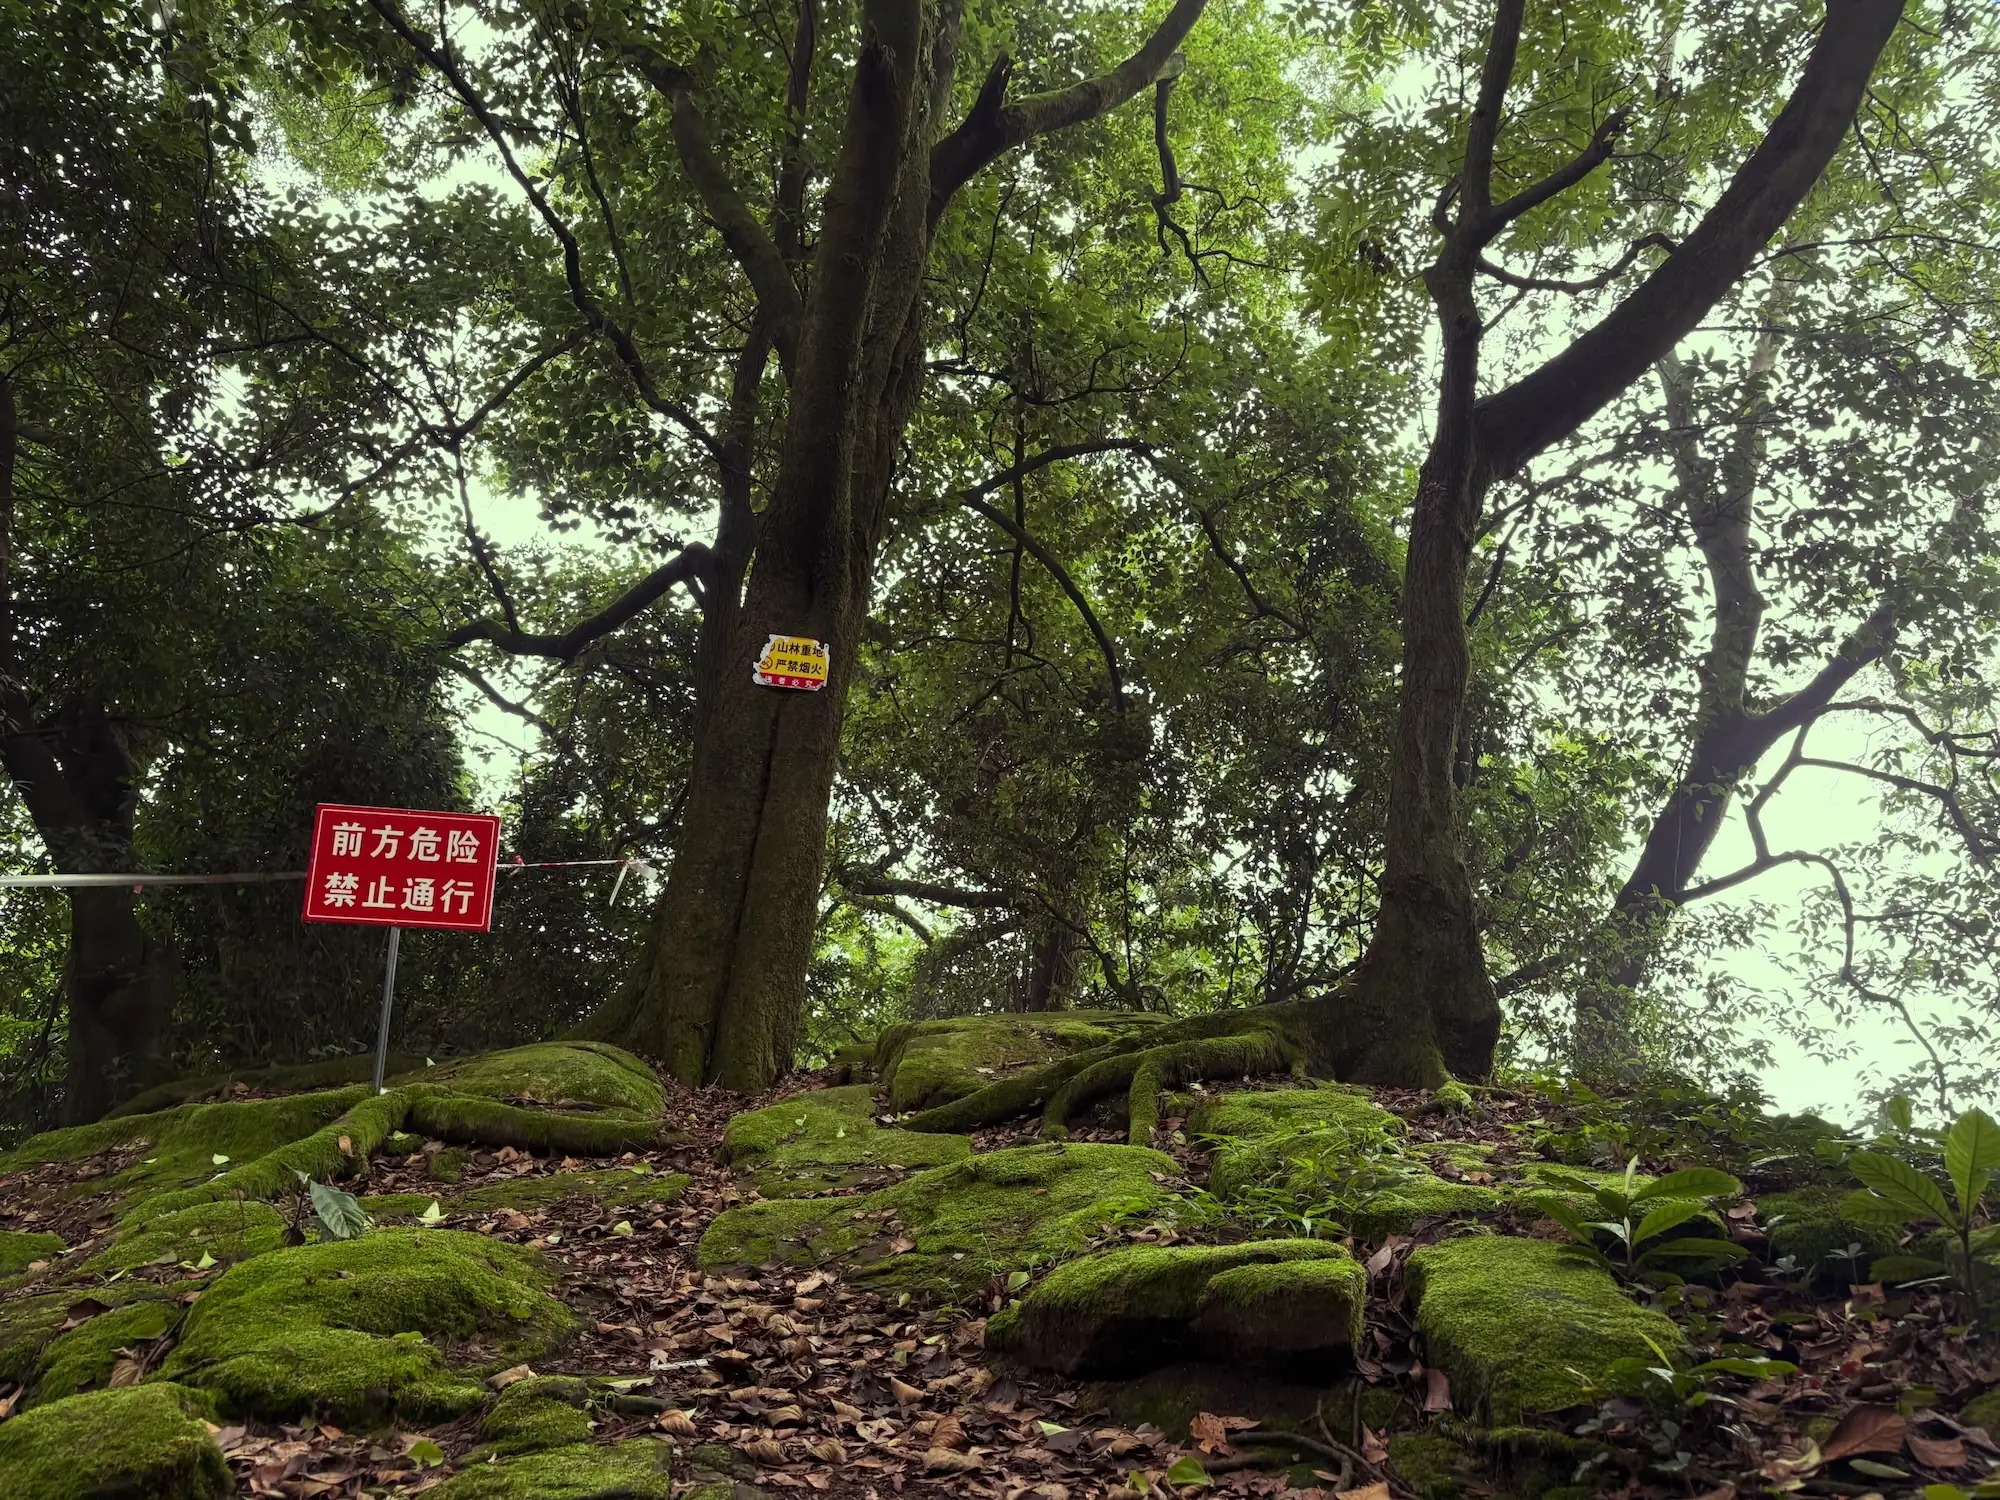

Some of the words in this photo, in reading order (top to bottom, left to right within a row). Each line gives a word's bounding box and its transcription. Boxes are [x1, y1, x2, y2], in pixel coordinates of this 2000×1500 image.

[775, 658, 823, 675] 严禁烟火
[331, 821, 481, 864] 前方危险
[323, 871, 475, 915] 禁止通行
